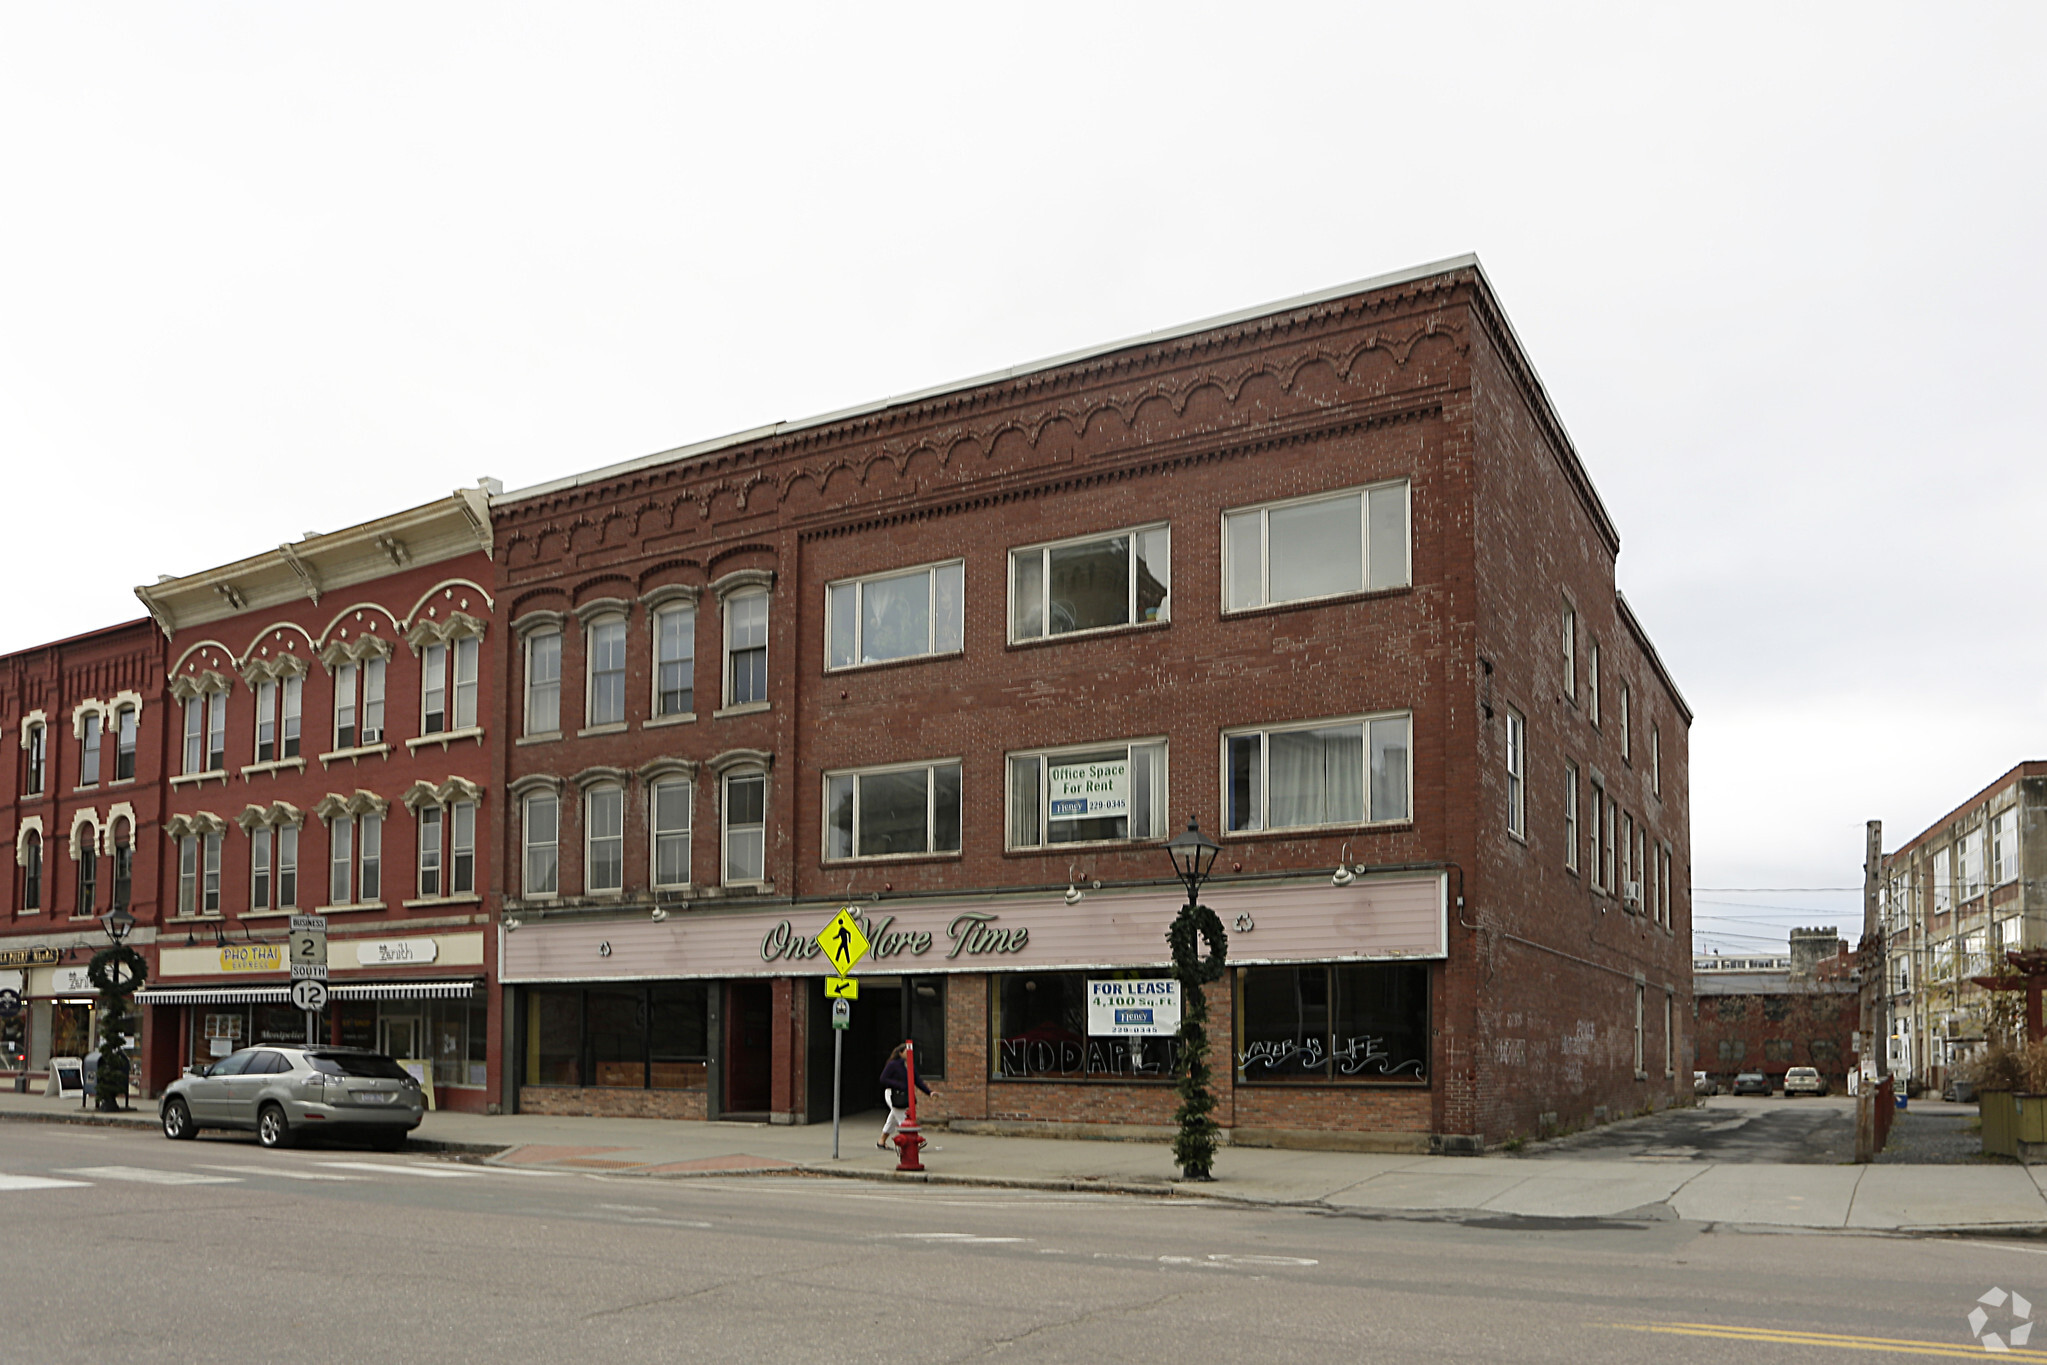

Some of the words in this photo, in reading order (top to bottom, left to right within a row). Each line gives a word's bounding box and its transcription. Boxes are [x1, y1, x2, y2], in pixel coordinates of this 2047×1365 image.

[1052, 767, 1086, 781] Office
[1089, 765, 1125, 779] Space
[1063, 782, 1082, 794] For
[1086, 779, 1113, 792] Rent
[1057, 802, 1083, 813] Heney
[1089, 799, 1126, 810] 229-0345
[292, 918, 325, 927] BUSINESS
[761, 919, 819, 962] One
[946, 911, 1029, 960] Time
[301, 938, 315, 956] 2
[379, 942, 413, 961] Zenith
[224, 948, 249, 961] PHO
[251, 947, 278, 960] THAI
[292, 965, 325, 976] SOUTH
[299, 986, 321, 1003] 12
[1093, 983, 1123, 995] FOR
[1127, 982, 1175, 995] LEASE
[1092, 997, 1136, 1007] 4,100
[1121, 1013, 1148, 1022] Heney
[261, 1030, 305, 1041] Montpelier
[1235, 1039, 1298, 1063] WATER
[1306, 1037, 1323, 1057] IS
[1332, 1034, 1389, 1060] LIFE
